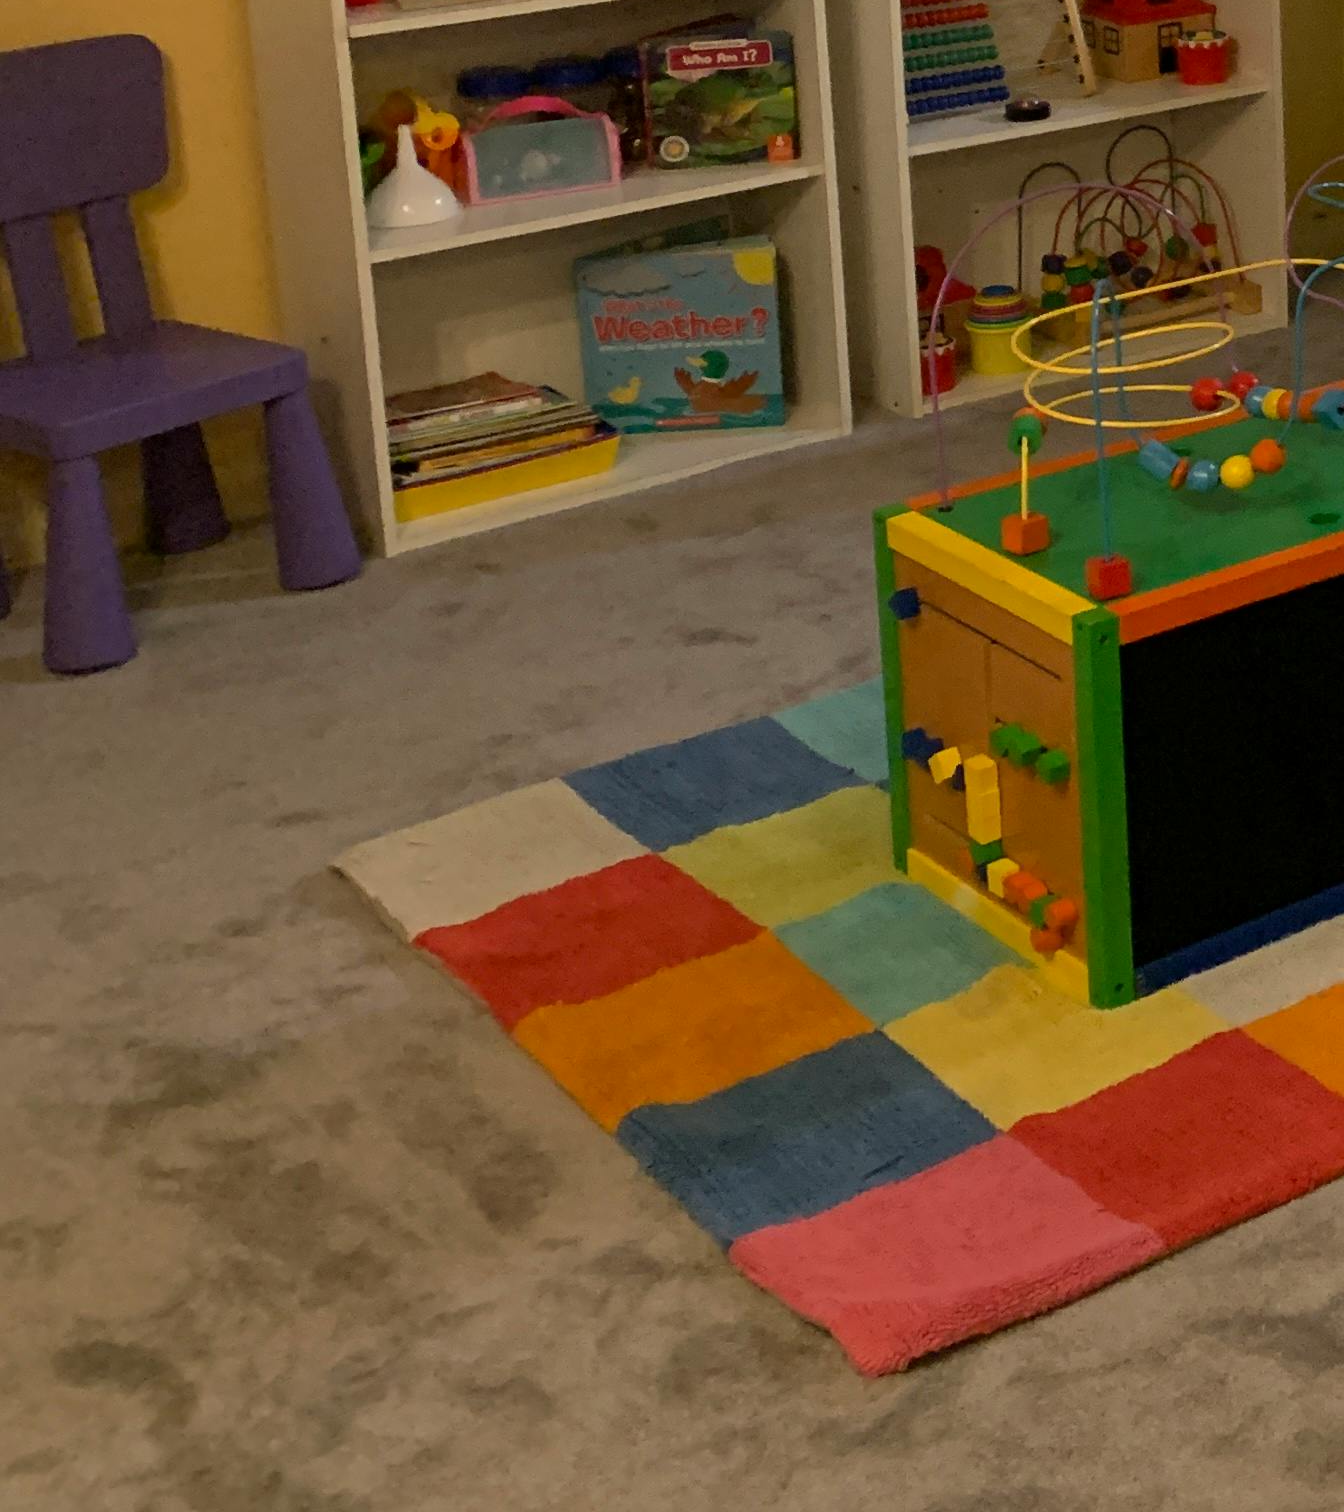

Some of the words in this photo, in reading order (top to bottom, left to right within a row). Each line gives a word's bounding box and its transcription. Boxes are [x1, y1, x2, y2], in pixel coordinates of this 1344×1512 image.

[683, 53, 713, 65] Who
[716, 52, 738, 64] Am
[742, 48, 758, 61] I?
[593, 307, 769, 345] Weather?
